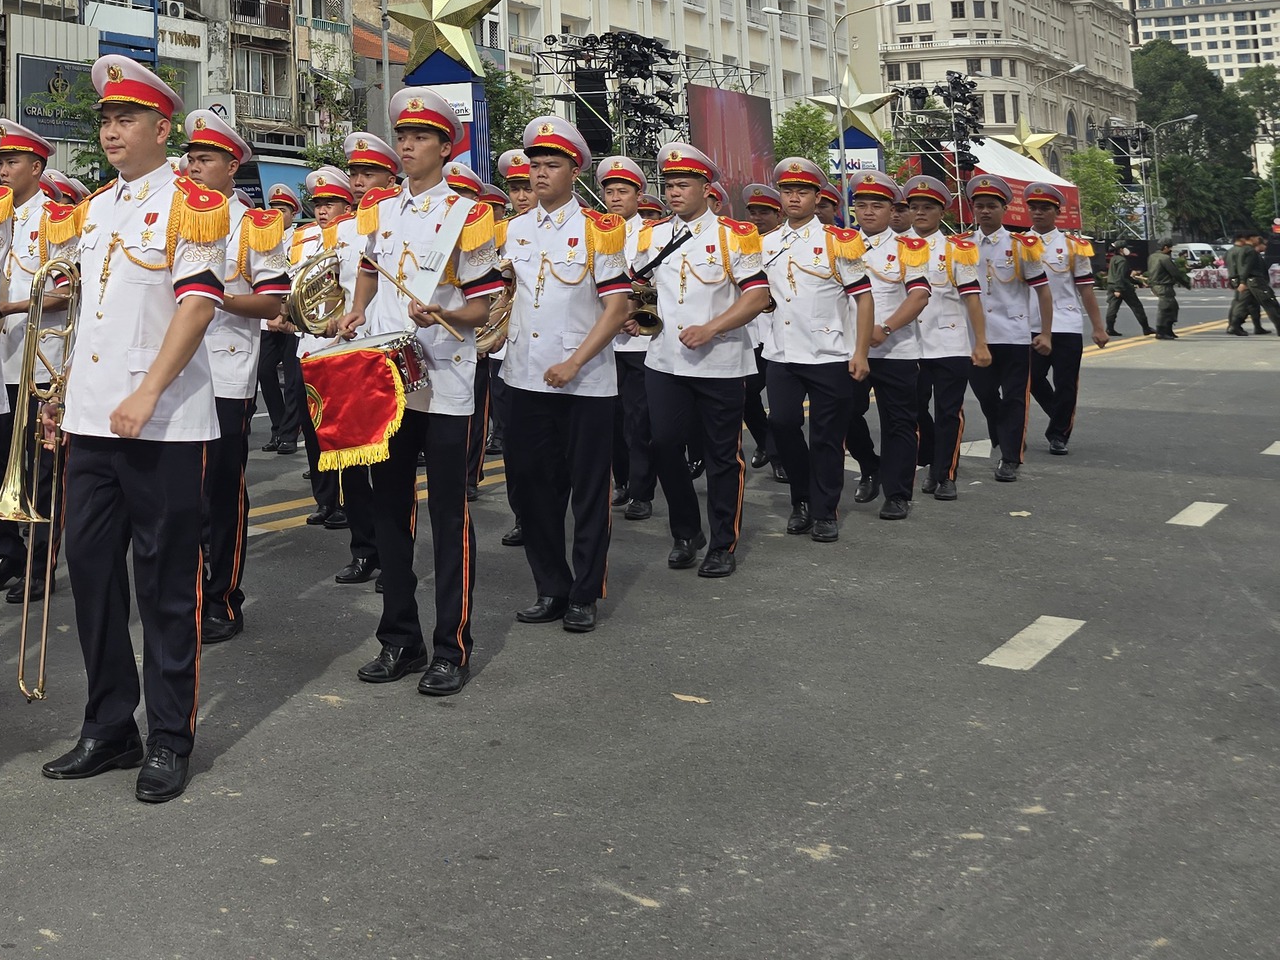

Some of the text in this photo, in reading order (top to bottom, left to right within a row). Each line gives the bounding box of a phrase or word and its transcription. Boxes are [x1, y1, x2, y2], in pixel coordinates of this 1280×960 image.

[25, 105, 53, 117] GRAND
[452, 106, 470, 114] ank
[831, 158, 861, 170] Vkki
